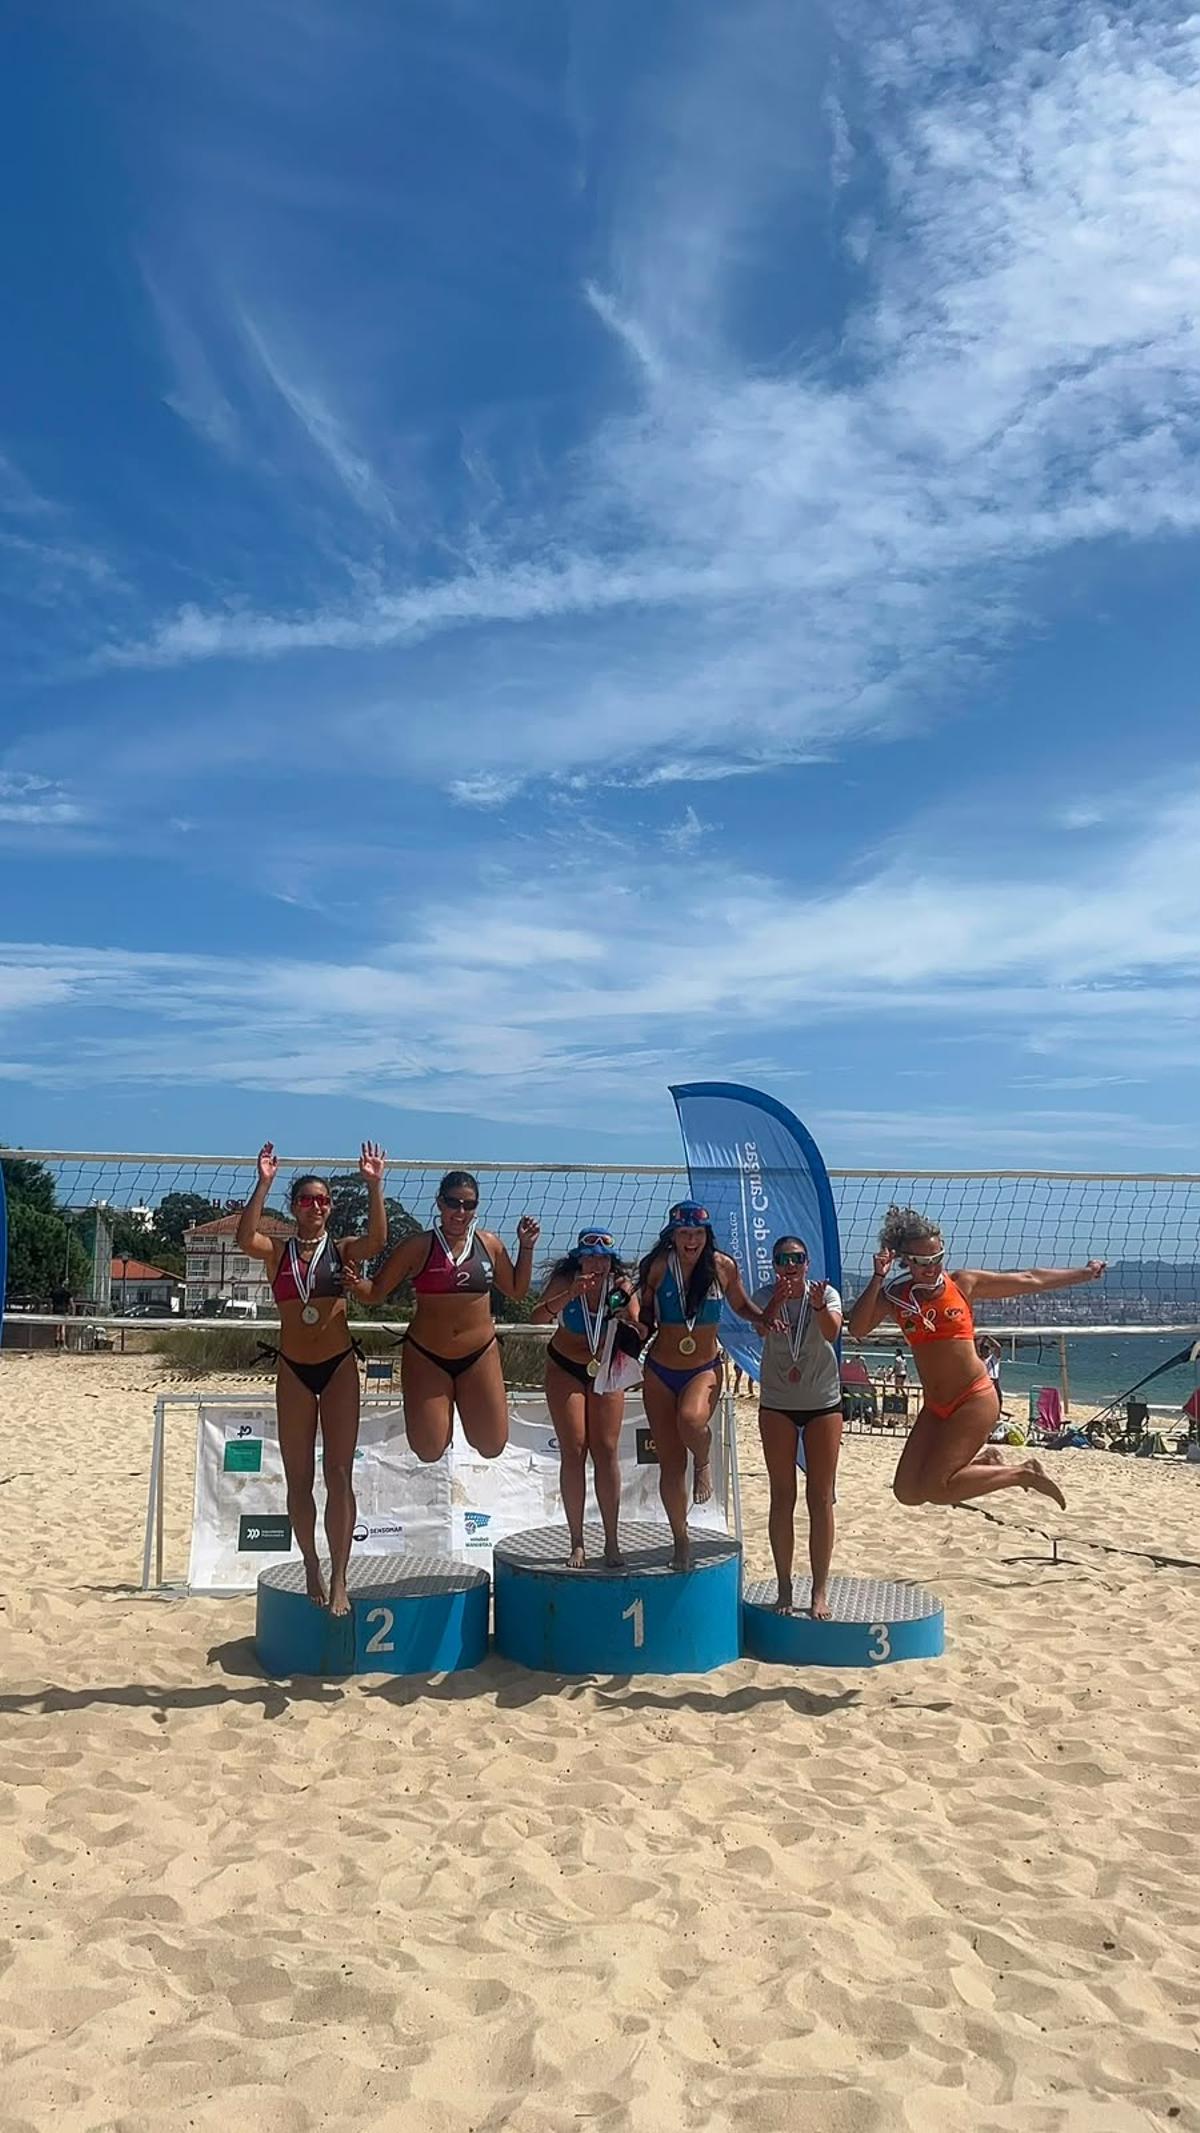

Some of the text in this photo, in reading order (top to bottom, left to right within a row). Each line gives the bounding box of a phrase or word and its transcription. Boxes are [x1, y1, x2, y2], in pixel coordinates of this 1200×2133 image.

[456, 1271, 471, 1286] 2
[366, 1607, 395, 1652] 2
[622, 1598, 644, 1648] 1
[868, 1623, 891, 1661] 3
